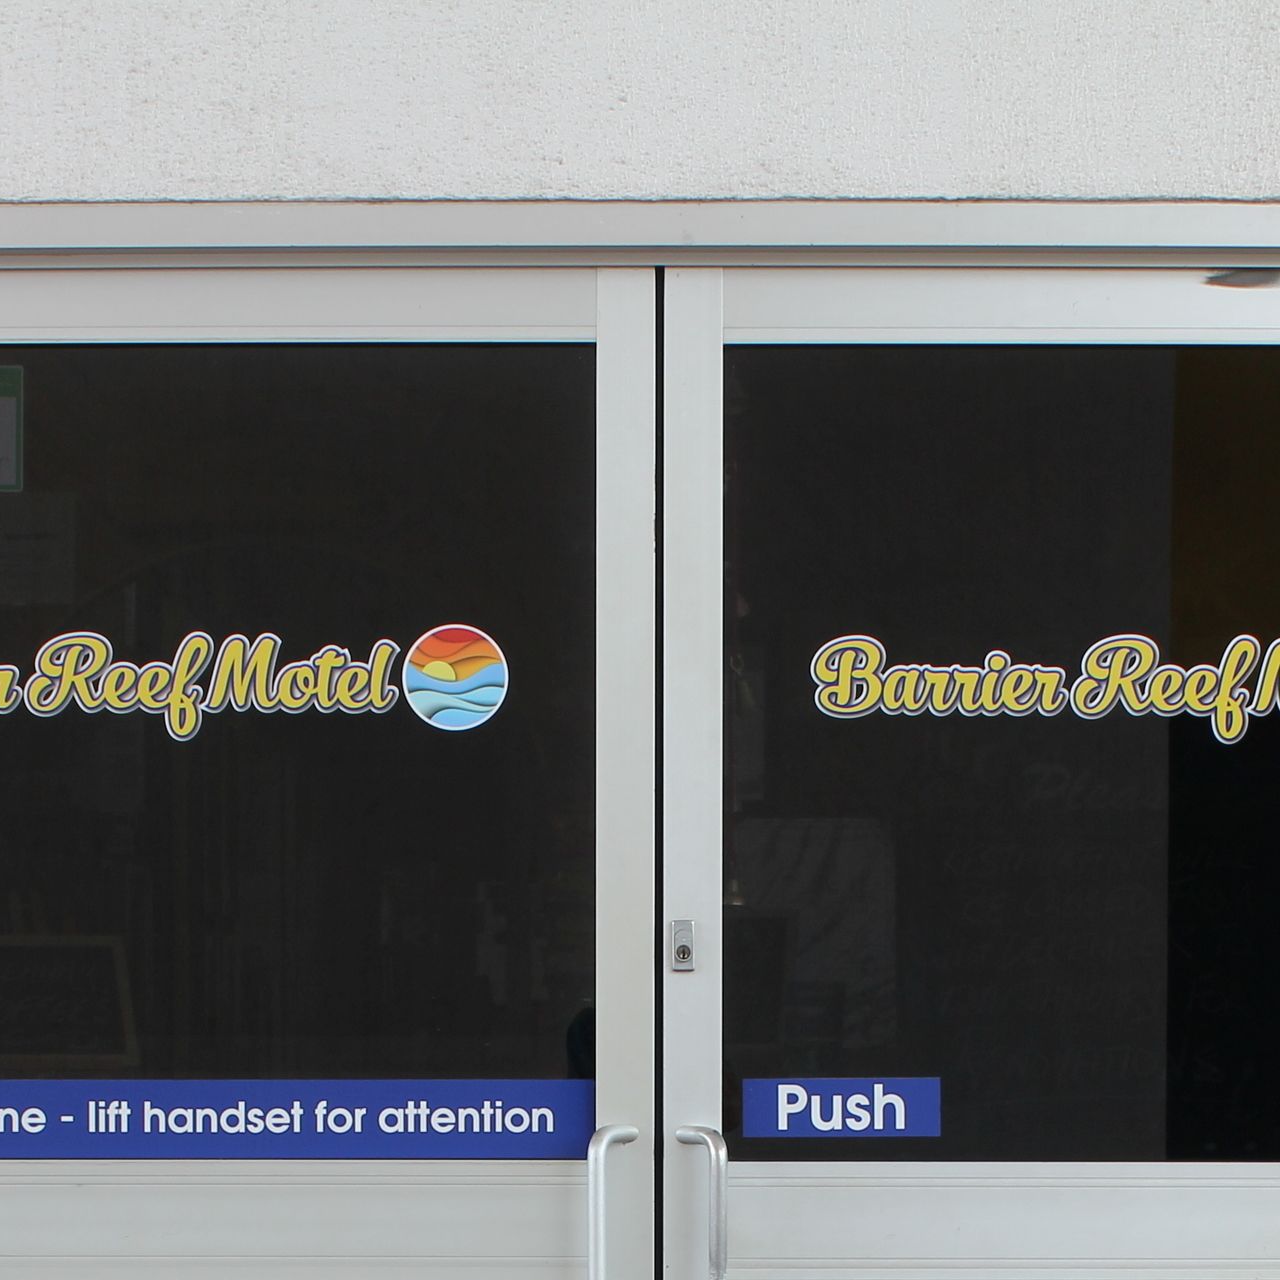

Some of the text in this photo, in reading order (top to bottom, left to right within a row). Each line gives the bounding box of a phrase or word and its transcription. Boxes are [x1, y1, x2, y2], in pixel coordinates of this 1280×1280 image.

[27, 630, 210, 741] Reef
[204, 632, 401, 717] Motel
[810, 634, 1069, 719] Barrier
[1070, 634, 1260, 745] Reef
[87, 1100, 131, 1133] lift
[143, 1100, 304, 1133] handset
[314, 1100, 367, 1133] for
[378, 1100, 554, 1133] attention
[777, 1083, 906, 1131] Push
